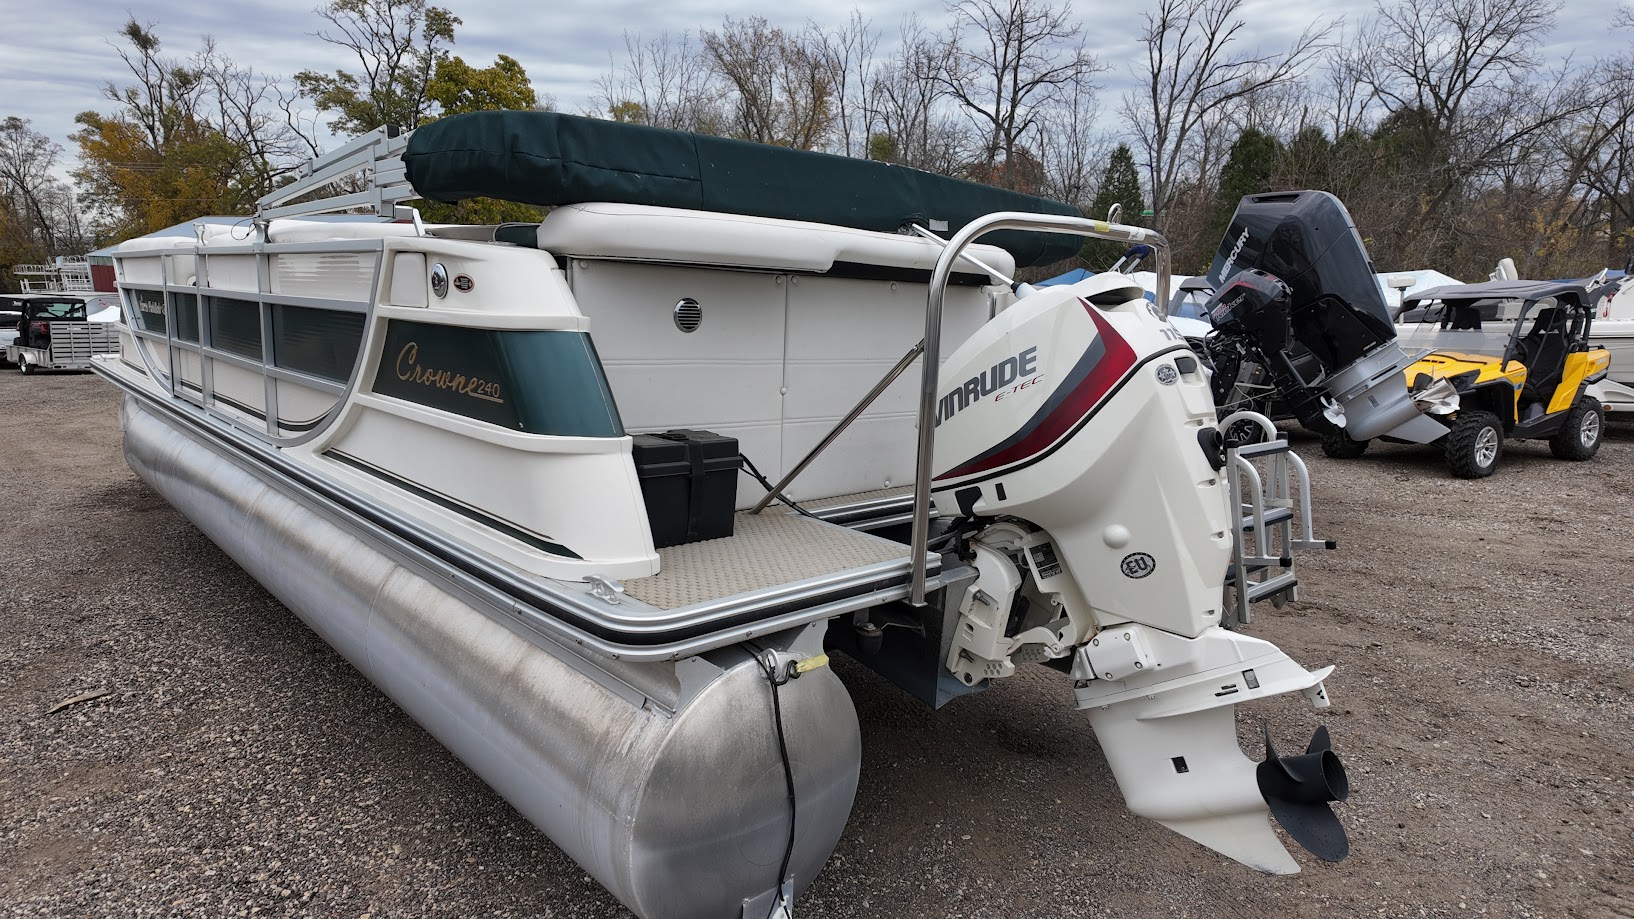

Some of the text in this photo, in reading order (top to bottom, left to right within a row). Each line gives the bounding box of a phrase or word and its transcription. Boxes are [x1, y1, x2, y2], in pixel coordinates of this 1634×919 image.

[1218, 226, 1250, 284] MERCURY
[396, 341, 500, 398] Crowne 240
[935, 345, 1037, 428] VINRUDE
[994, 373, 1045, 402] E-TEC
